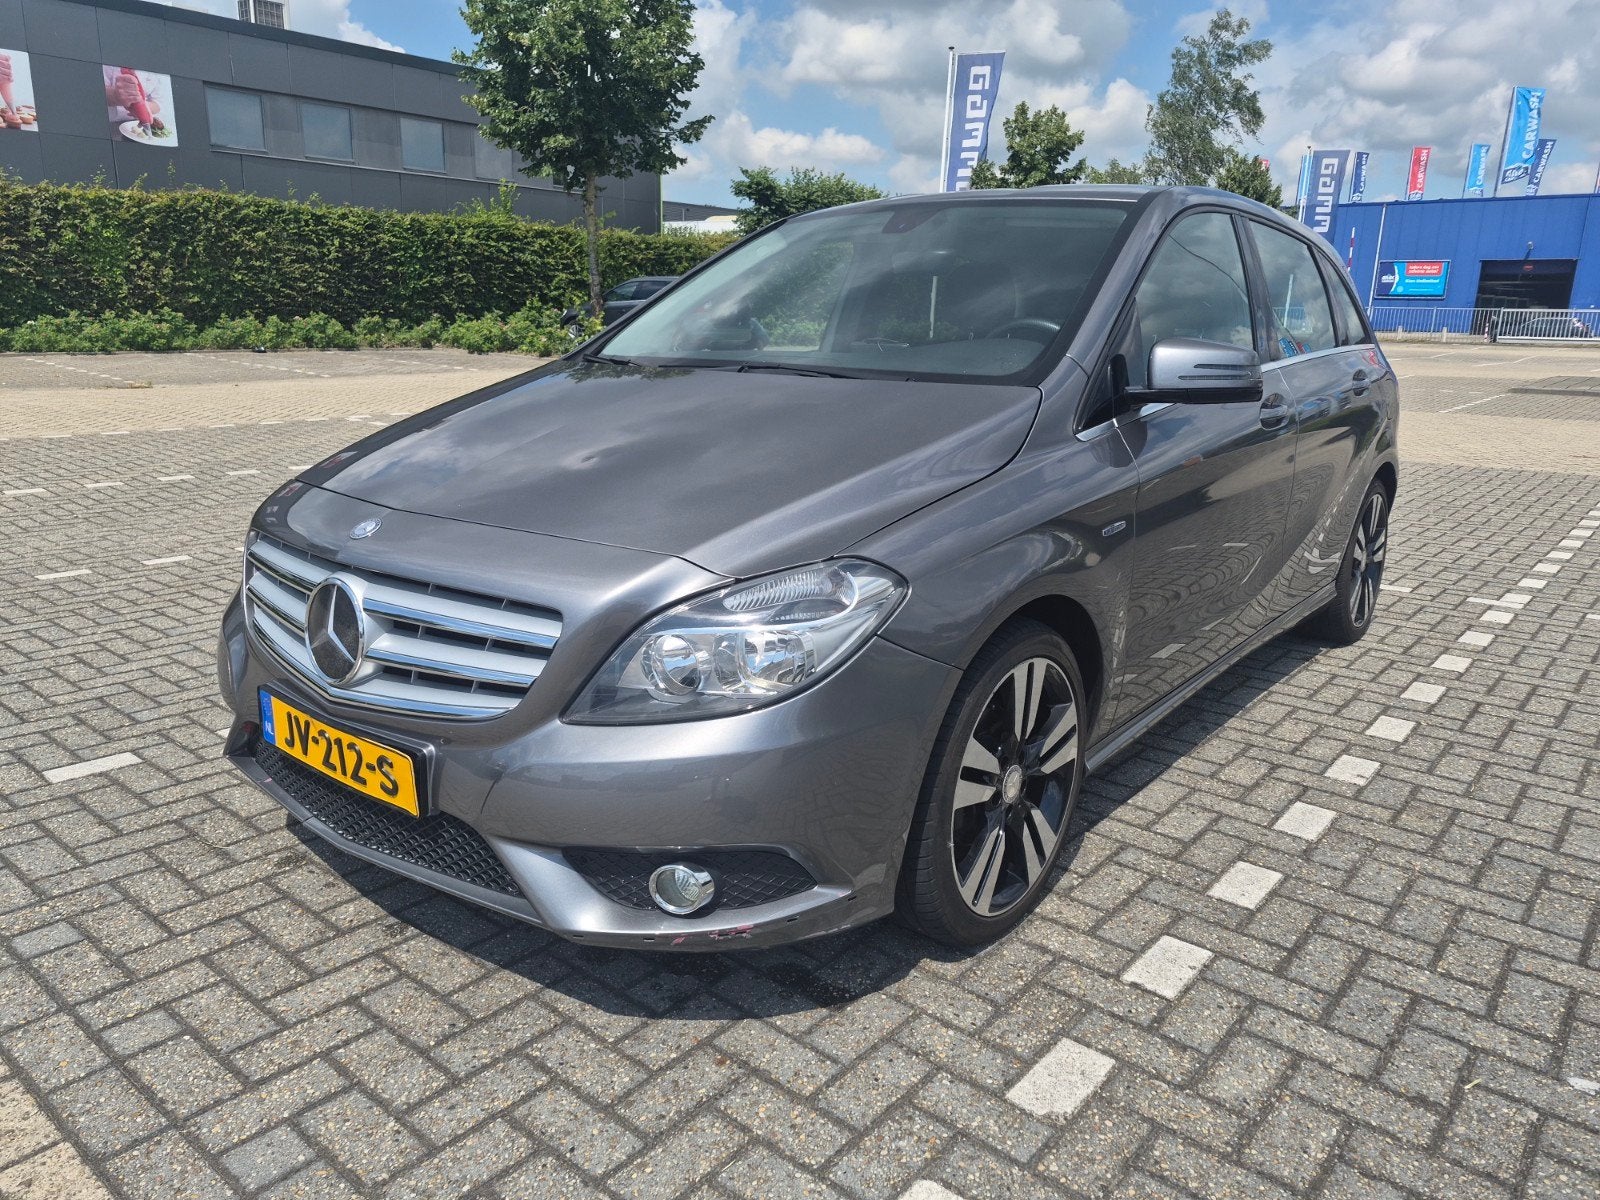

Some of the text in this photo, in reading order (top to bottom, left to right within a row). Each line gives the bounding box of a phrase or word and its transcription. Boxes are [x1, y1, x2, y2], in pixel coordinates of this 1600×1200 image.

[1521, 91, 1542, 159] CARWASH
[1416, 149, 1429, 188] CARWASH
[1533, 141, 1554, 183] CARWASH
[264, 720, 275, 735] NL
[284, 711, 399, 797] JV-212-S
